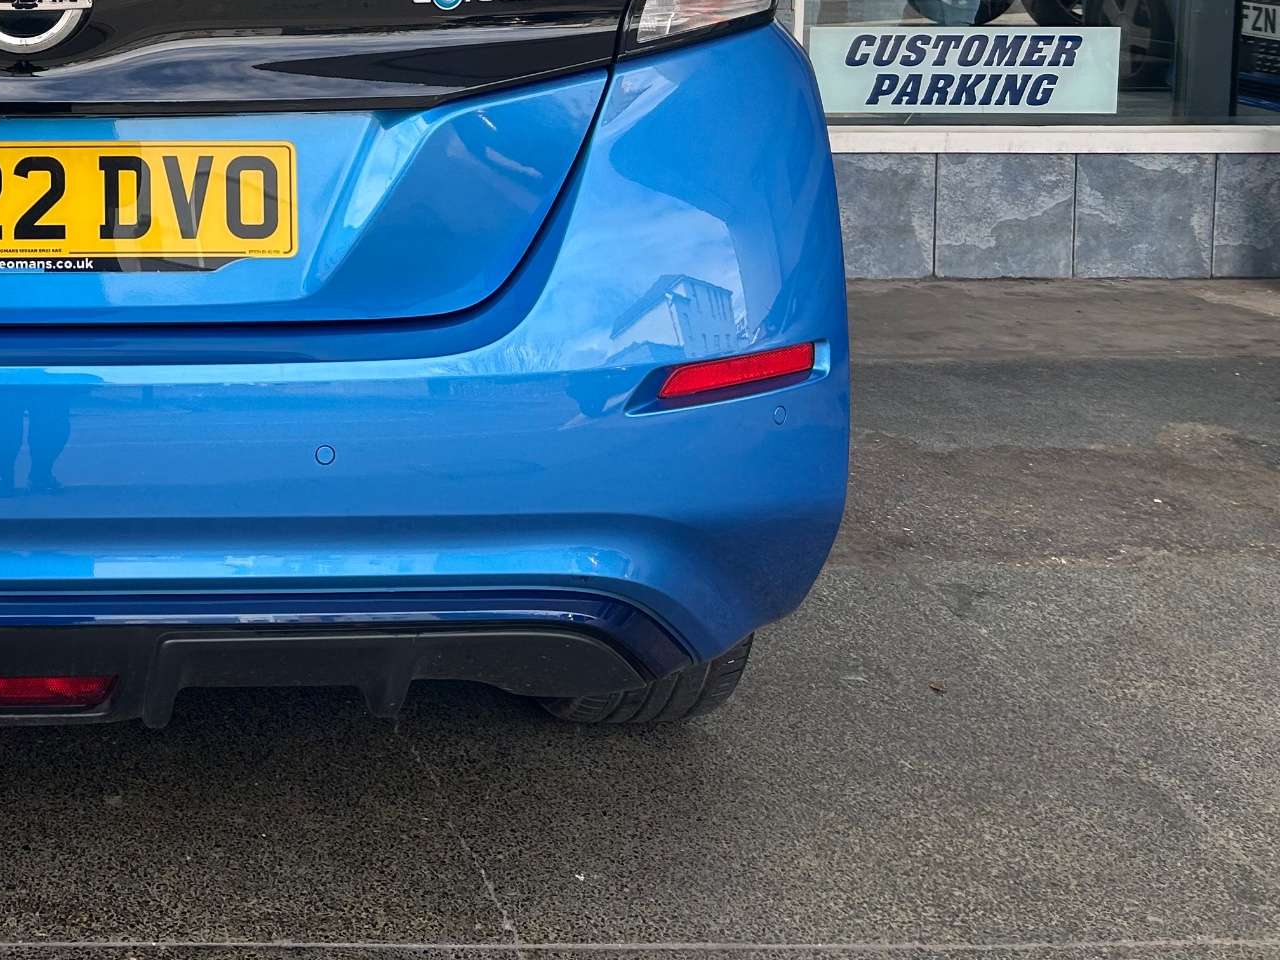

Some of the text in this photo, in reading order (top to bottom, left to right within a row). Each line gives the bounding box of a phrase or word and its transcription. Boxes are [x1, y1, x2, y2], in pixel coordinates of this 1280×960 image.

[844, 34, 1083, 67] CUSTOMER
[865, 73, 1059, 107] PARKING
[98, 155, 279, 240] DVO
